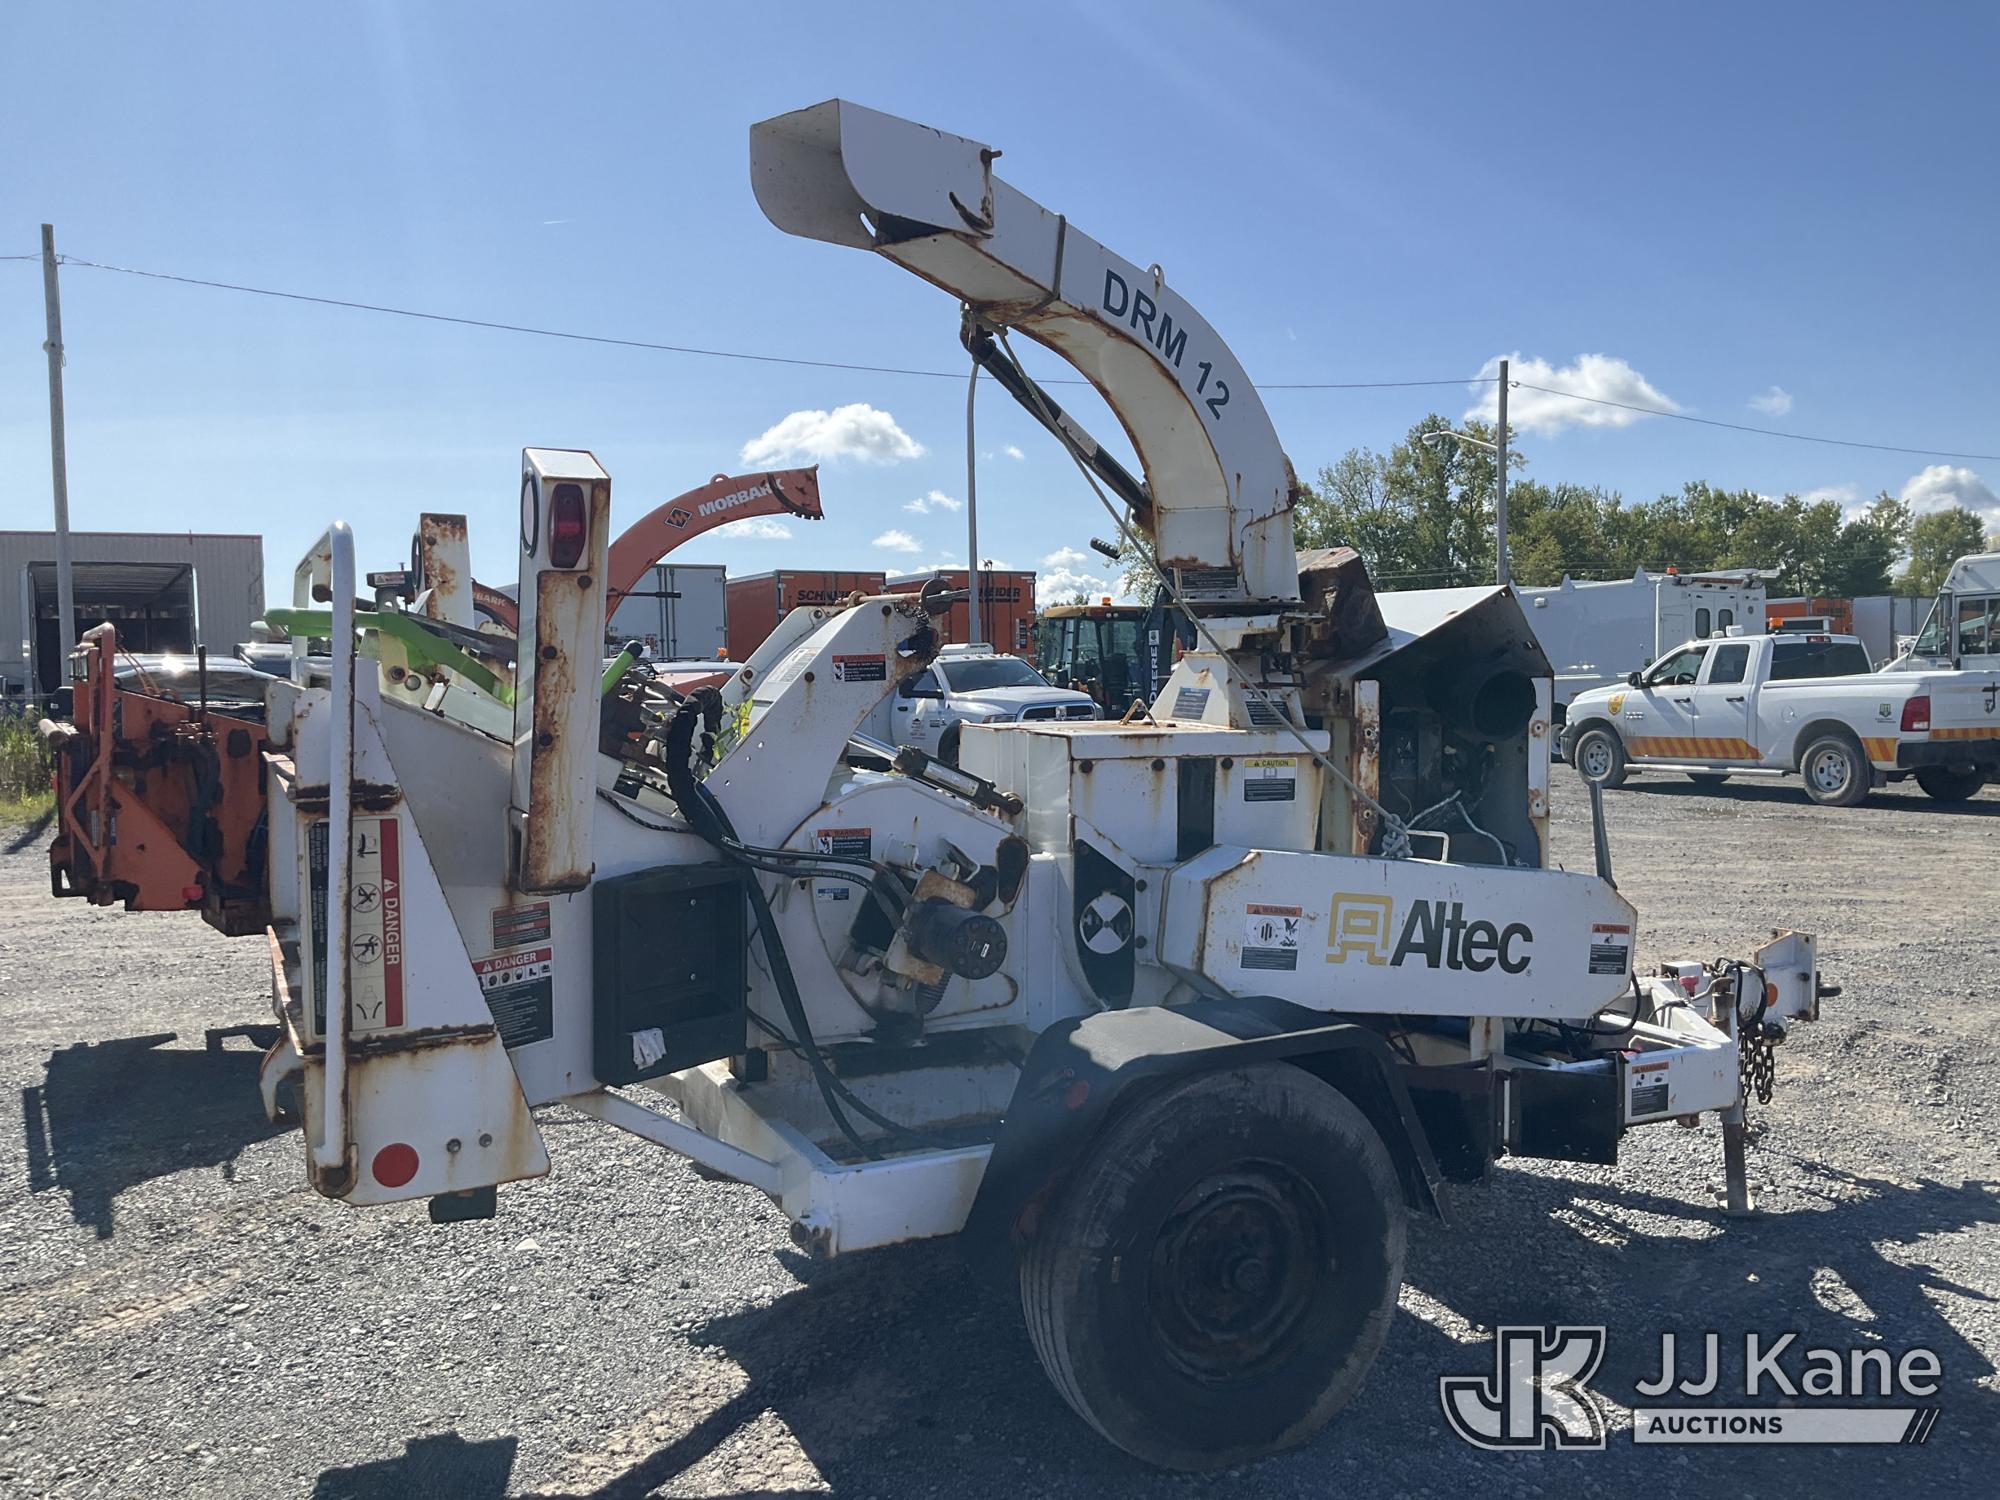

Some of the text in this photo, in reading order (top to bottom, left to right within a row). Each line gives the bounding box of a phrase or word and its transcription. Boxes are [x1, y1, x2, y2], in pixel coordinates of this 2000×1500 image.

[1103, 268, 1231, 421] DRM 12
[473, 592, 508, 607] BARK
[1149, 645, 1158, 705] DEERE
[384, 898, 400, 966] DANGER
[494, 952, 537, 970] DANGER
[1389, 899, 1534, 975] Altec
